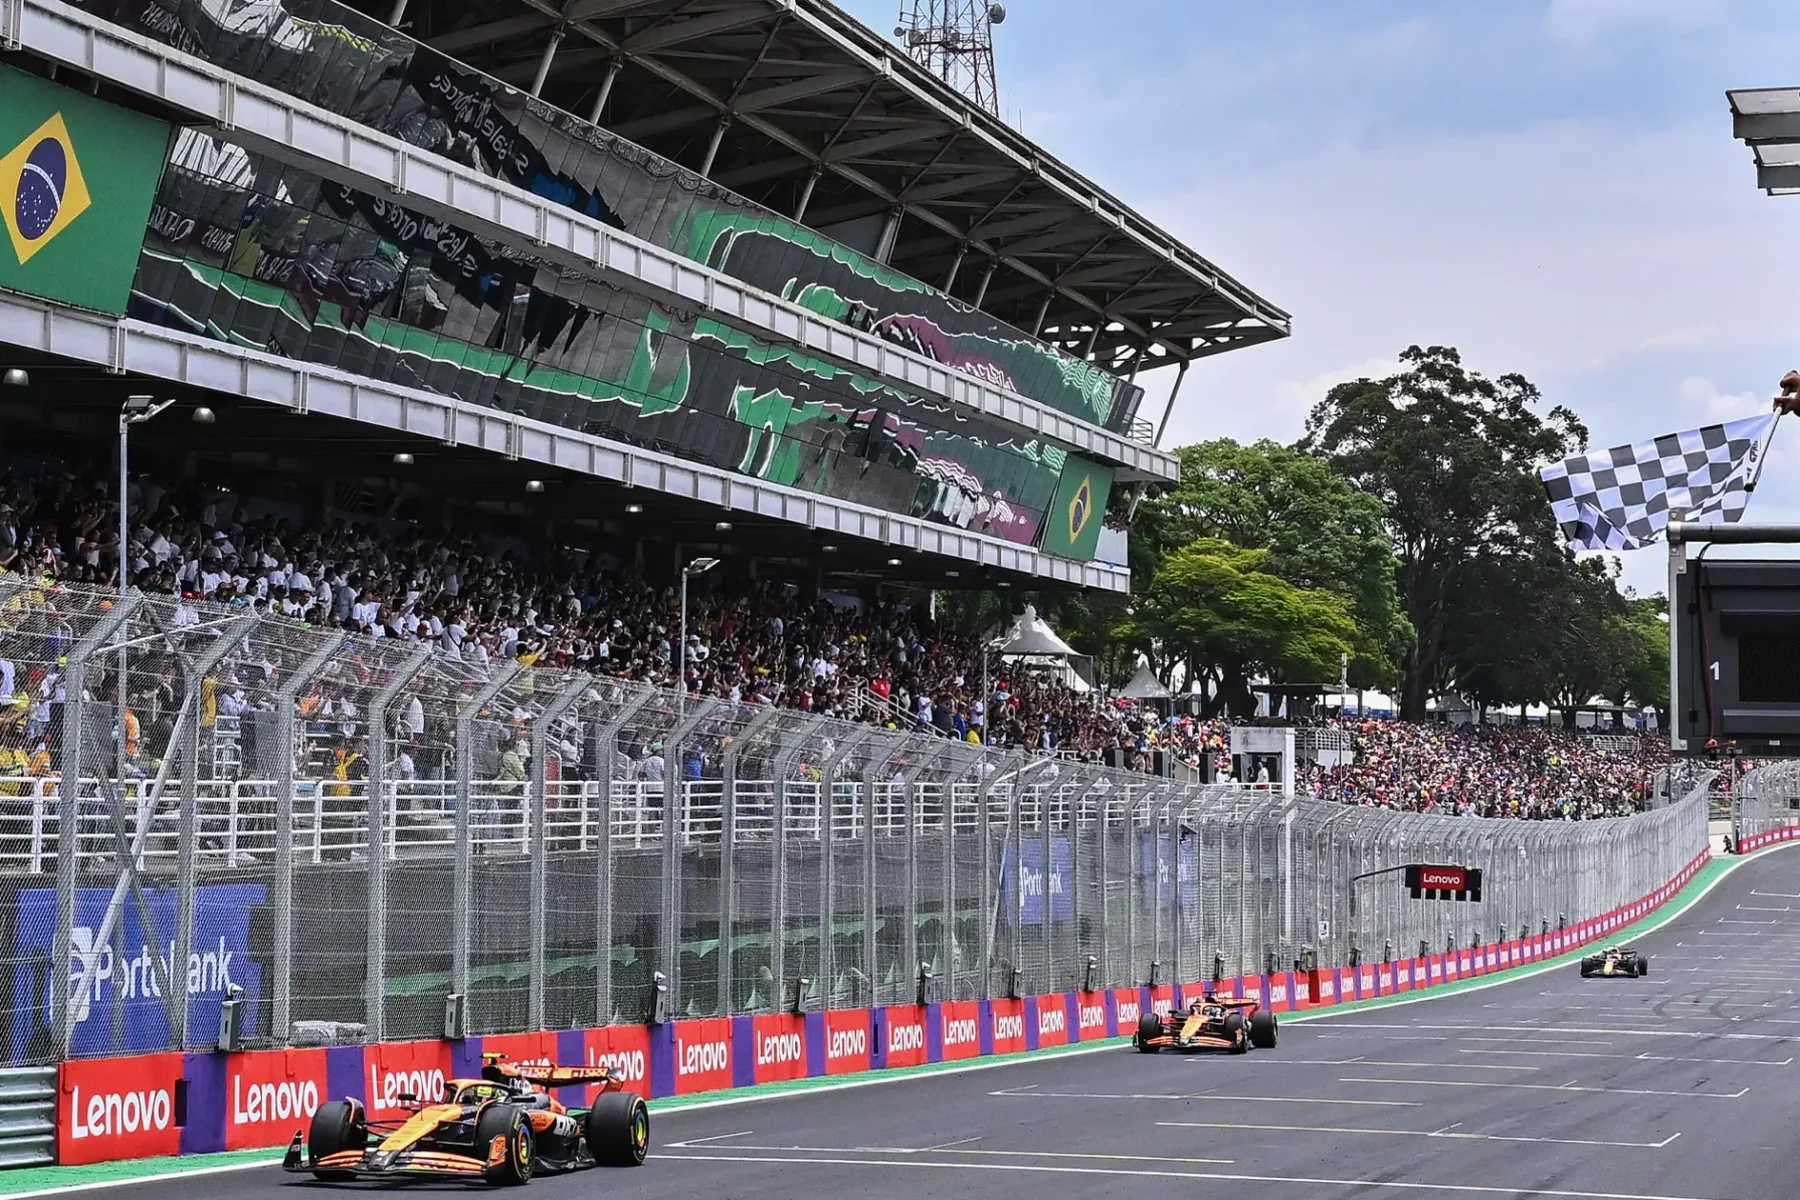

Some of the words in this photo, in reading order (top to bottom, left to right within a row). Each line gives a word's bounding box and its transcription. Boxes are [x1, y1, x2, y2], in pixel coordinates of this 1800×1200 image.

[1710, 661, 1720, 680] 1
[1423, 873, 1461, 885] Lenovo
[994, 1012, 1023, 1040] Lenovo
[1037, 1008, 1065, 1035] Lenovo
[1079, 1003, 1104, 1029] Lenovo
[1116, 998, 1140, 1024] Lenovo
[827, 1025, 866, 1059] Lenovo
[888, 1021, 923, 1053] Lenovo
[943, 1016, 975, 1045] Lenovo
[678, 1038, 728, 1075] Lenovo
[757, 1030, 801, 1065] Lenovo
[234, 1074, 318, 1124] Lenovo
[372, 1064, 445, 1109] Lenovo
[72, 1085, 170, 1139] Lenovo
